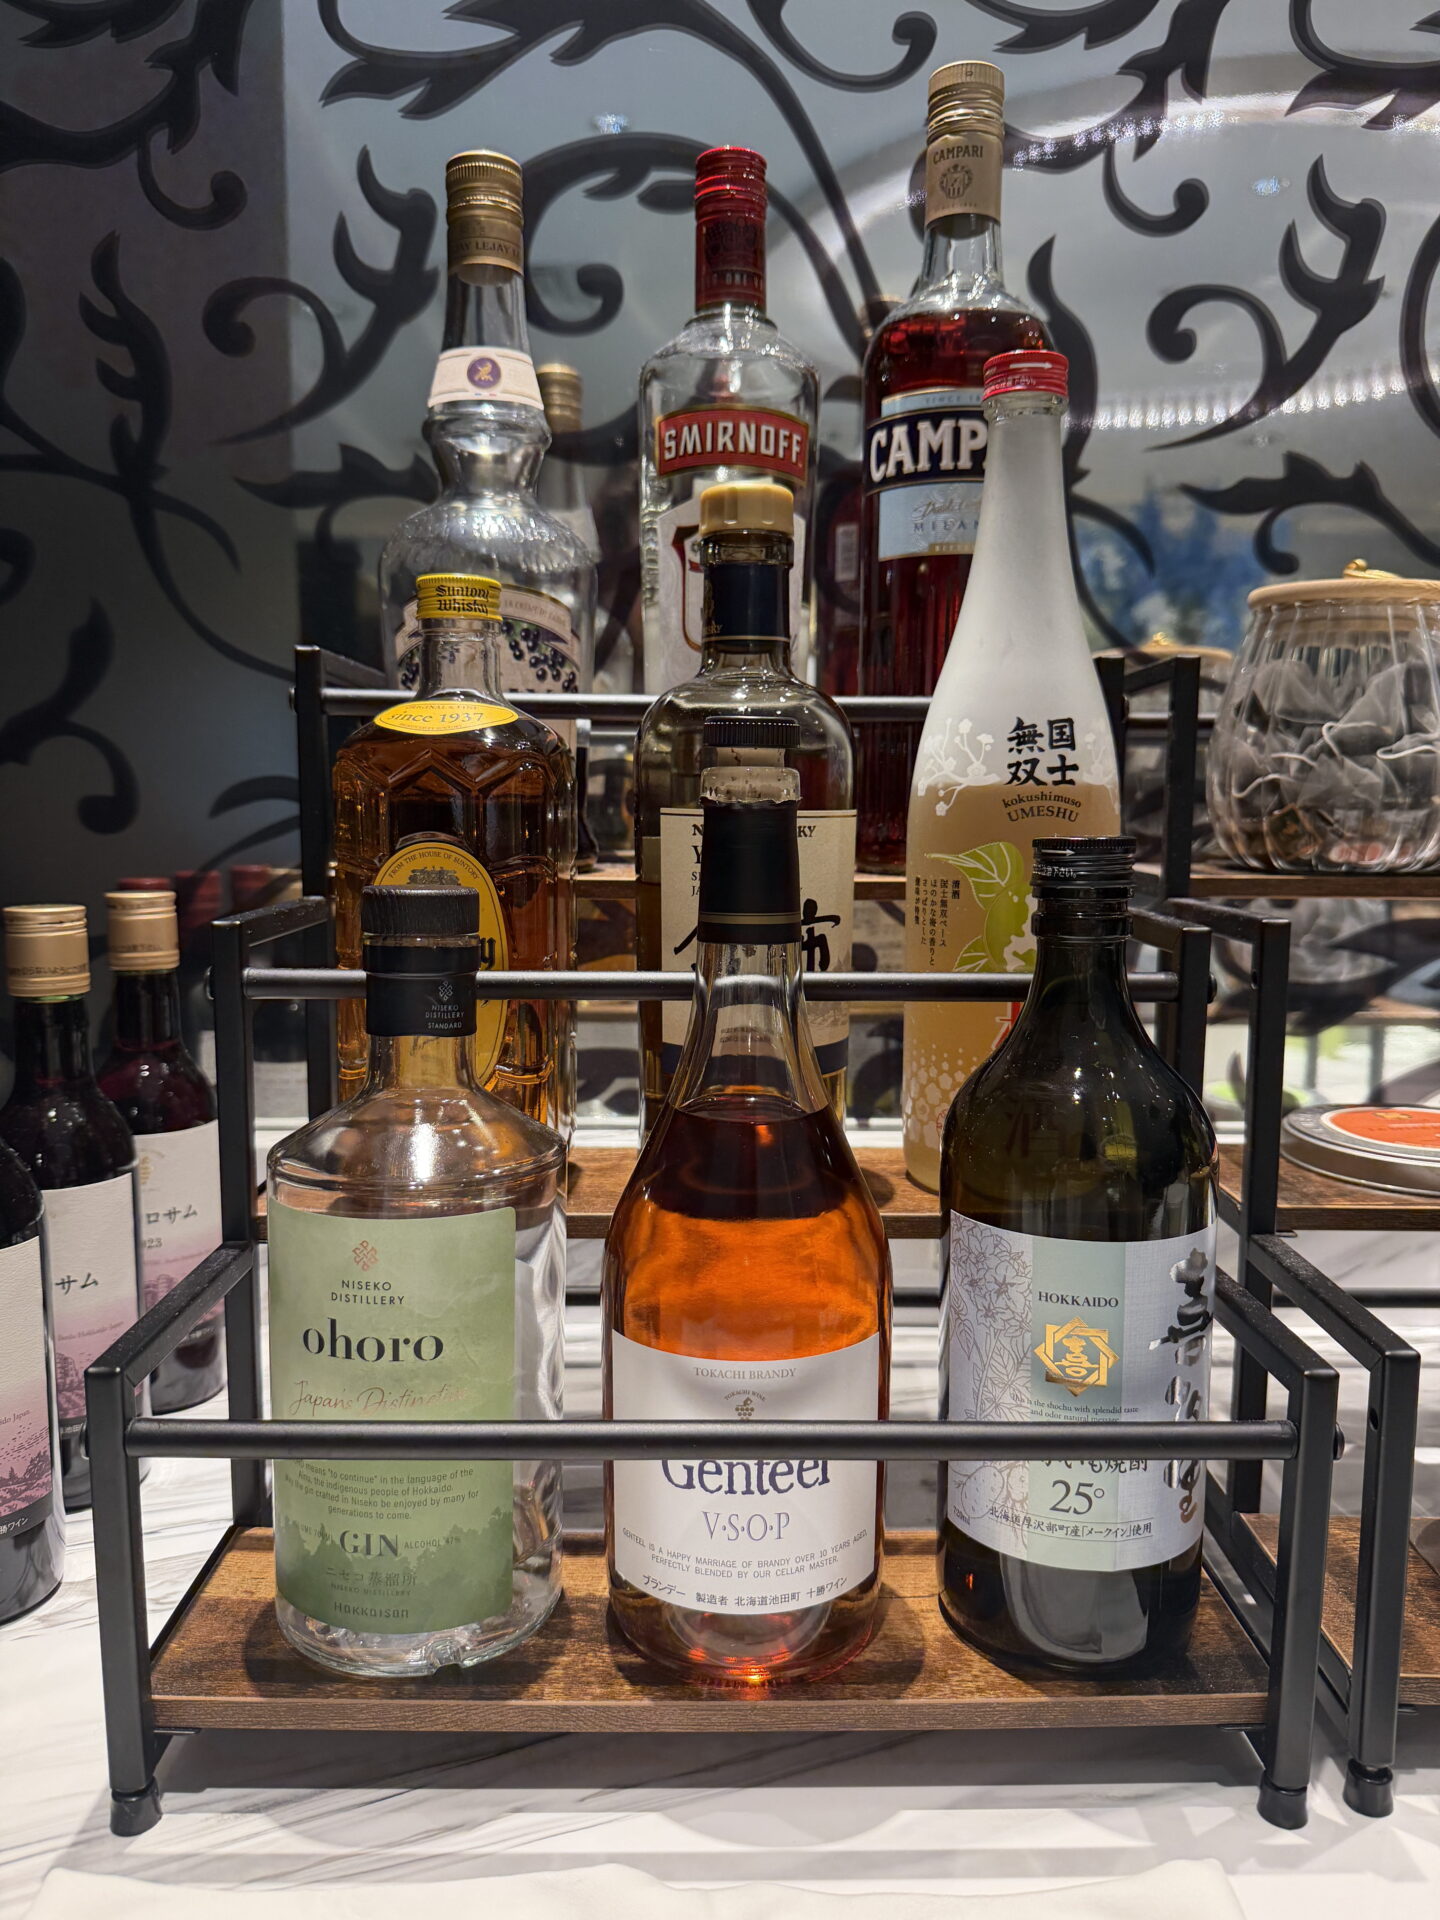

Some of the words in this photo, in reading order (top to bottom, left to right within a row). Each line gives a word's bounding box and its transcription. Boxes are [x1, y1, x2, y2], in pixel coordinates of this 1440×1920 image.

[933, 144, 984, 165] CAMPARI
[476, 241, 508, 254] LEJAY
[664, 421, 802, 460] SMIRNOFF
[870, 418, 988, 483] CAMP
[914, 519, 980, 532] MILA
[435, 584, 490, 602] Suntory
[437, 600, 488, 615] Whisky
[388, 709, 432, 723] since
[440, 712, 484, 724] 1937
[1002, 790, 1082, 808] kokushimuso
[1007, 806, 1079, 822] UMESHU
[388, 862, 404, 878] FROM
[406, 854, 417, 863] THE
[454, 857, 480, 880] SUNTORY
[426, 1011, 464, 1019] DISTILLERY
[146, 1204, 198, 1225] ロサム
[54, 1272, 98, 1296] サム
[341, 1280, 392, 1292] NISEKO
[330, 1292, 405, 1306] DISTILLERY
[1038, 1290, 1119, 1308] HOKKAIDO
[302, 1318, 444, 1362] ohoro
[694, 1367, 746, 1380] TOKACHI
[749, 1368, 797, 1380] BRANDY
[288, 1380, 353, 1417] Japan's
[724, 1389, 750, 1401] TOKACHI
[751, 1390, 766, 1402] WINE
[1030, 1408, 1042, 1416] and
[1044, 1410, 1061, 1420] odor
[1064, 1414, 1089, 1422] natural
[1034, 1400, 1046, 1408] the
[1046, 1401, 1072, 1412] shochu
[1074, 1404, 1090, 1414] with
[1092, 1405, 1122, 1416] splendid
[306, 1463, 326, 1476] means
[380, 1476, 388, 1484] in
[390, 1475, 404, 1484] the
[407, 1474, 448, 1485] language
[450, 1469, 458, 1480] of
[460, 1468, 474, 1478] the
[314, 1477, 324, 1487] the
[326, 1480, 368, 1494] indigenous
[370, 1488, 398, 1497] people
[402, 1486, 410, 1496] of
[412, 1484, 454, 1496] Hokkaido.
[316, 1489, 340, 1503] crafted
[342, 1495, 349, 1505] in
[351, 1497, 378, 1508] Niseko
[380, 1499, 391, 1508] be
[394, 1498, 428, 1510] enjoyed
[430, 1498, 440, 1508] by
[444, 1493, 466, 1504] many
[468, 1490, 480, 1500] for
[328, 1506, 374, 1519] generations
[376, 1511, 384, 1520] to
[386, 1512, 412, 1520] come.
[0, 1516, 28, 1535] 勝ワイン
[339, 1530, 400, 1558] GIN
[404, 1538, 442, 1550] ALCOHOL
[622, 1527, 646, 1548] GENTEEL
[648, 1542, 655, 1552] IS
[666, 1549, 691, 1562] HAPPY
[696, 1557, 737, 1568] MARRIAGE
[742, 1560, 752, 1568] OF
[758, 1557, 791, 1568] BRANDY
[794, 1552, 816, 1564] OVER
[820, 1548, 828, 1558] 10
[830, 1540, 850, 1554] YEARS
[852, 1529, 868, 1544] AGED,
[651, 1554, 691, 1572] PERFECTLY
[694, 1566, 733, 1578] BLENDED
[738, 1570, 748, 1579] BY
[753, 1570, 771, 1578] OUR
[775, 1565, 805, 1578] CELLAR
[809, 1556, 838, 1570] MASTER.
[330, 1584, 360, 1594] NISEKO
[364, 1588, 412, 1597] DISTILLERY
[642, 1574, 686, 1596] ブランデー
[696, 1592, 728, 1606] 製造者
[734, 1592, 801, 1606] 北海道池田町
[806, 1577, 848, 1599] 十勝ワイン
